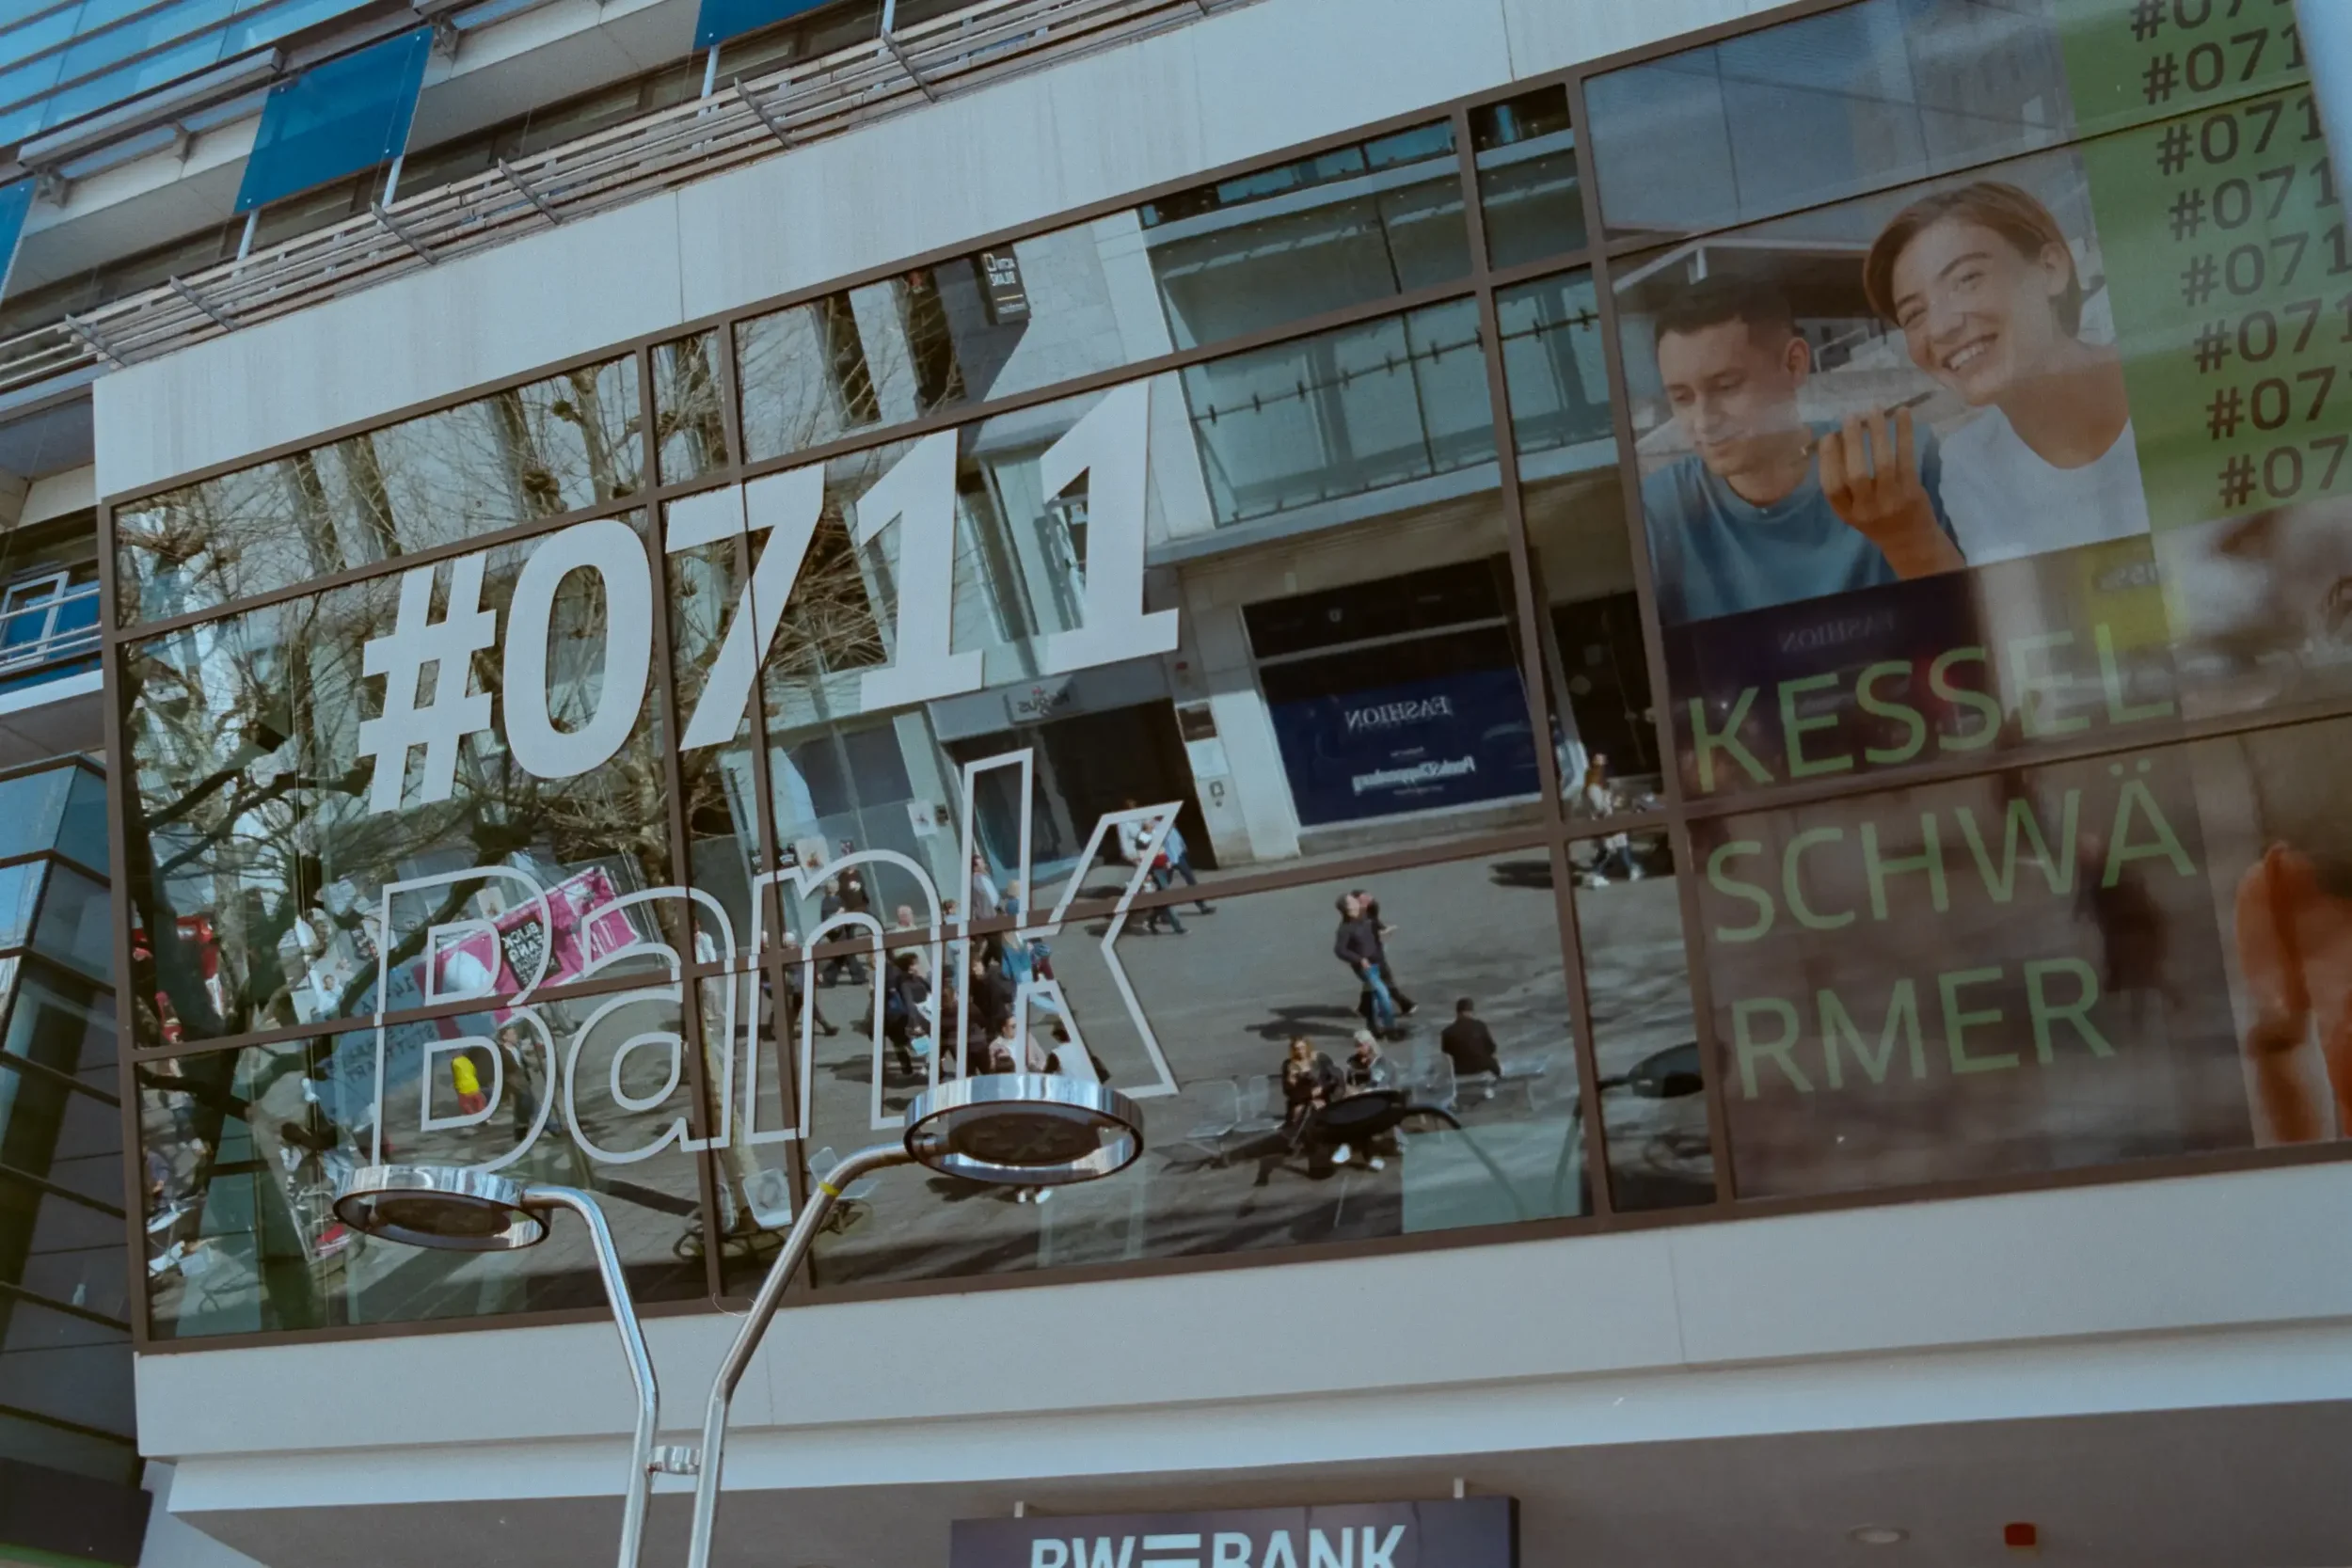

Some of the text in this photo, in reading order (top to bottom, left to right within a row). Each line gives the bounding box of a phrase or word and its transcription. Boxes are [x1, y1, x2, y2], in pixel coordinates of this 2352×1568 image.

[2130, 0, 2292, 41] #0
[2142, 23, 2305, 105] #071
[2156, 95, 2324, 176] #071
[2169, 156, 2340, 241] #071
[2181, 222, 2352, 307] #071
[2205, 365, 2352, 440] #07
[2218, 434, 2350, 509] #07
[358, 380, 1180, 815] #0711
[1688, 623, 2175, 794] KESSEL
[1706, 758, 2198, 942] SCHWÄ
[372, 747, 1184, 1175] Bank
[1731, 957, 2116, 1101] RMER
